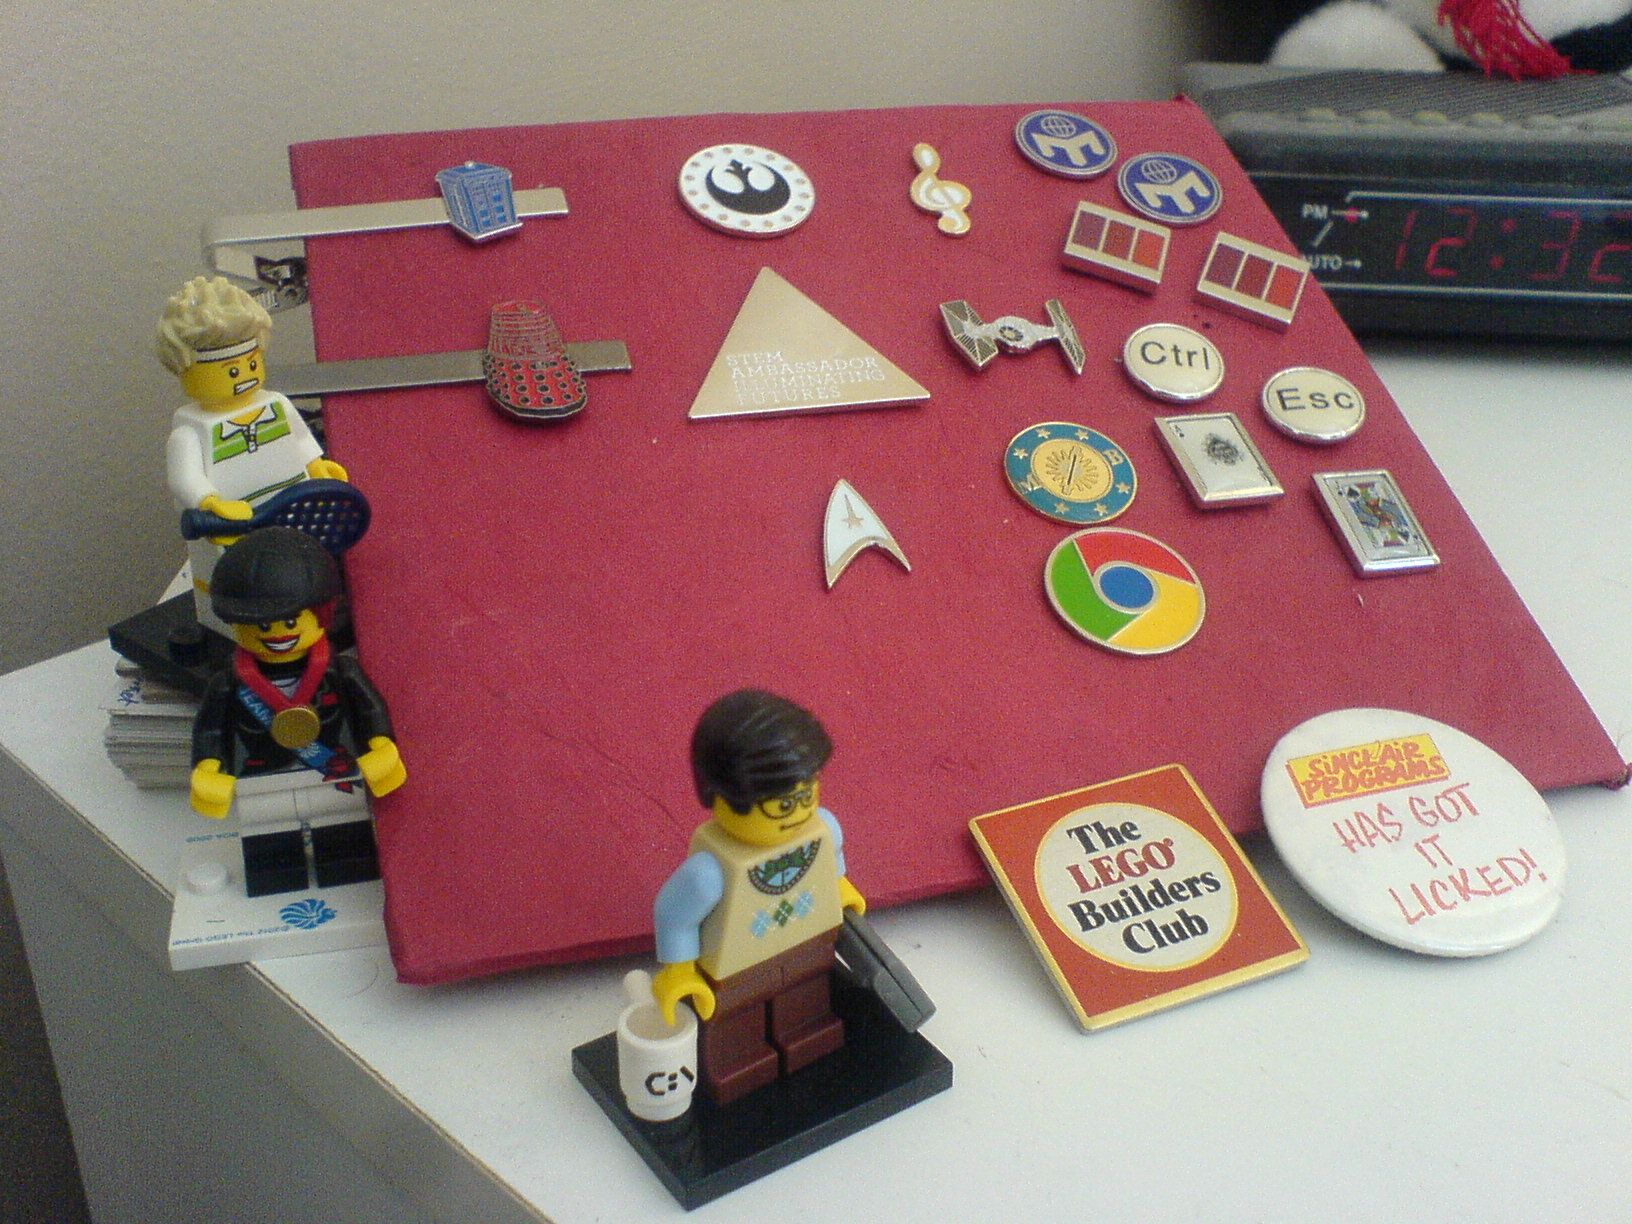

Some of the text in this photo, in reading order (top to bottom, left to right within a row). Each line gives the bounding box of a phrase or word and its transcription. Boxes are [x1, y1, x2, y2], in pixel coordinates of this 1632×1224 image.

[1302, 203, 1328, 219] PM
[726, 351, 783, 366] STEM
[731, 357, 878, 379] AMBASSADOR
[1140, 341, 1210, 370] Ctrl
[1276, 387, 1355, 411] Esc
[1301, 755, 1446, 800] PROGRAMS
[1332, 782, 1480, 854] HAS GOT
[1067, 821, 1142, 855] The
[1414, 833, 1454, 868] IT
[1067, 871, 1222, 932] Builders
[1388, 848, 1548, 925] LICKED!
[1122, 909, 1210, 954] Club
